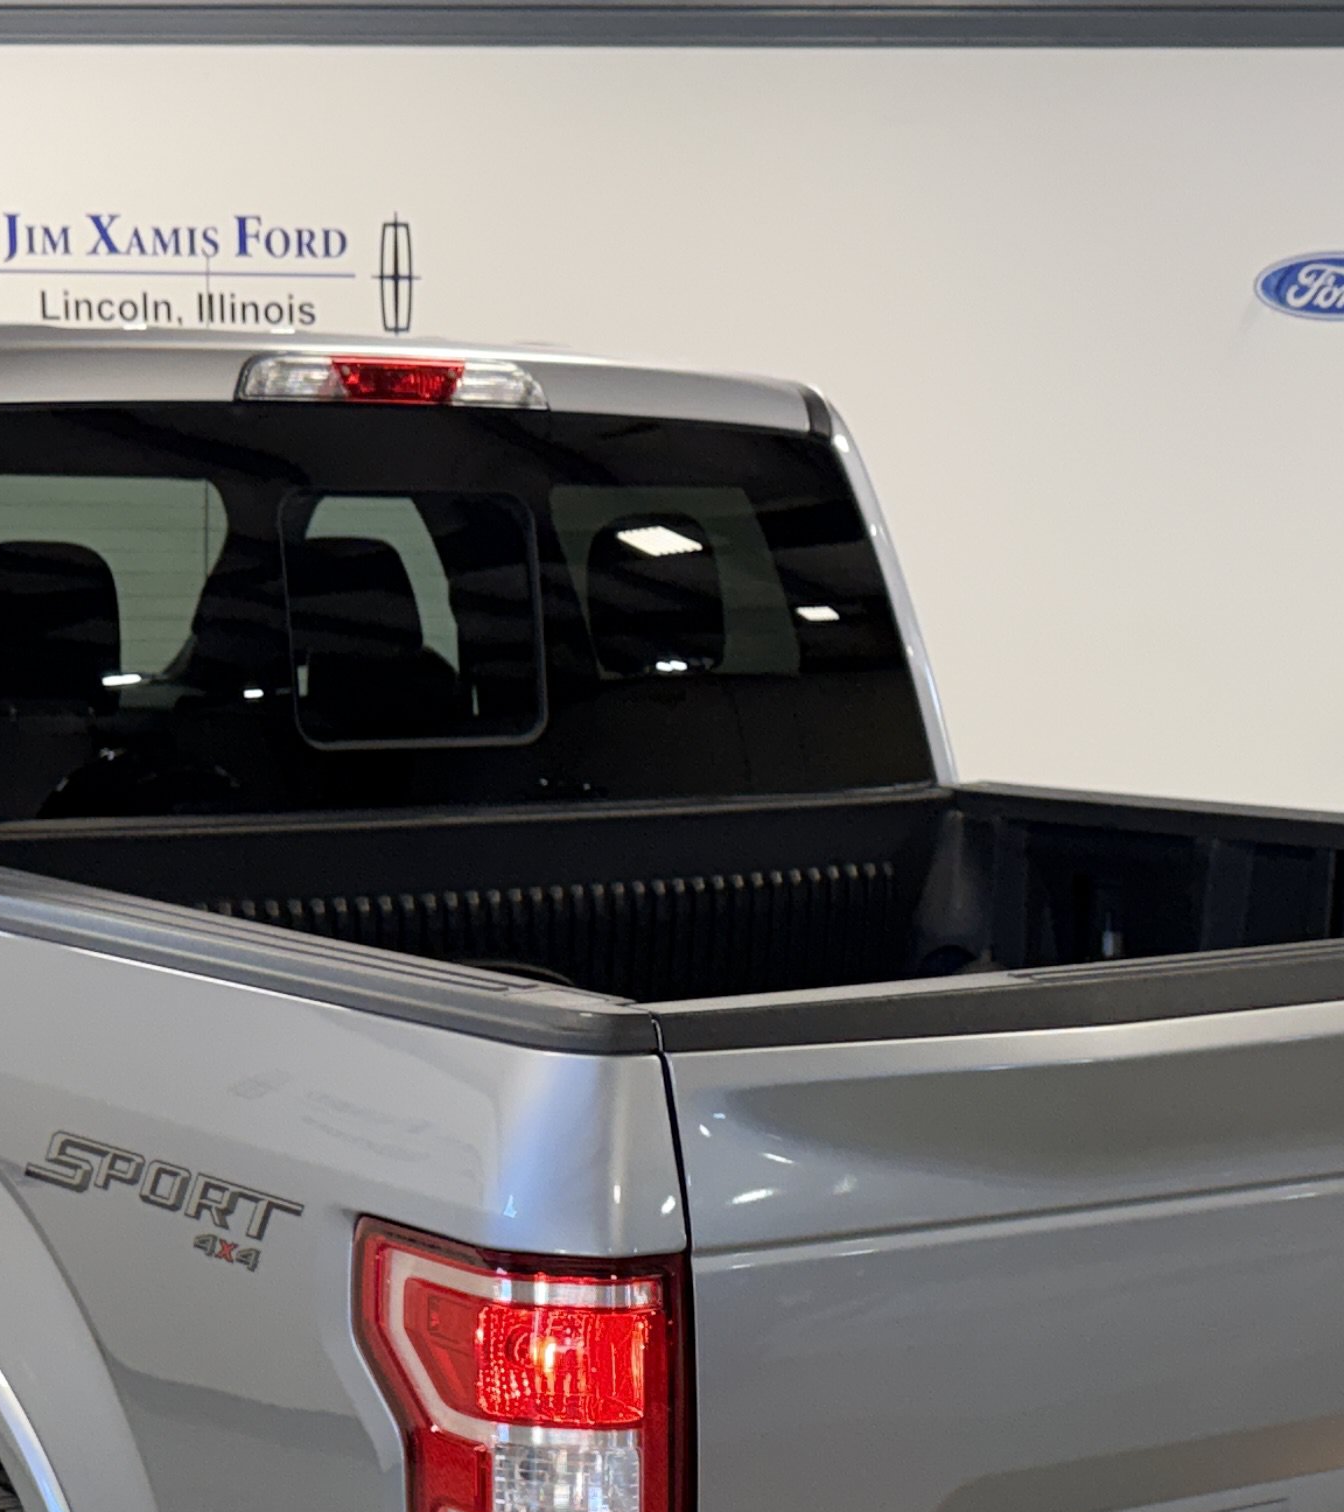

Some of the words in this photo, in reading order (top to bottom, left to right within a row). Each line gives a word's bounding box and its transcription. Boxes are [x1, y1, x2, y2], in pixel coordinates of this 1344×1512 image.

[2, 213, 70, 262] JIM
[85, 214, 219, 260] XAMIS
[234, 216, 347, 259] FORD
[40, 290, 183, 326] Lincoln,
[198, 292, 316, 326] Illinois
[24, 1129, 305, 1241] SPORT
